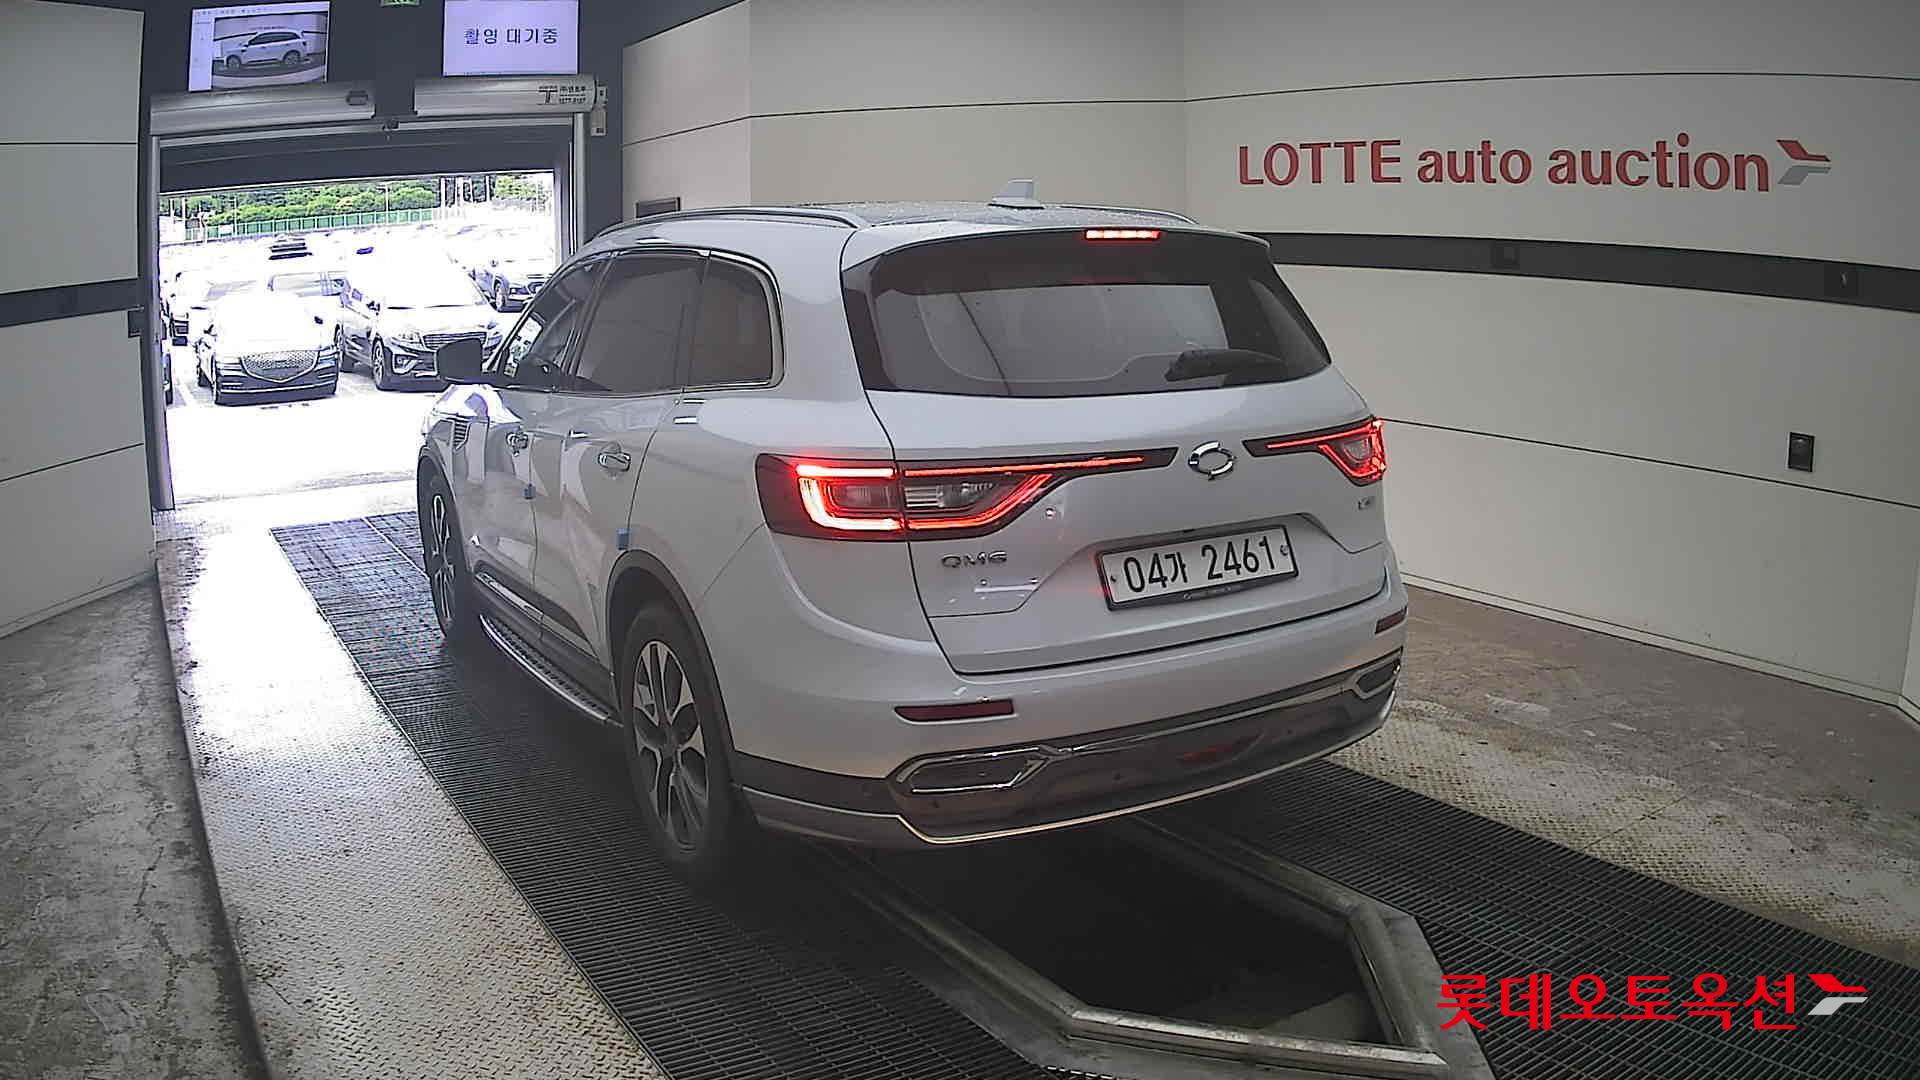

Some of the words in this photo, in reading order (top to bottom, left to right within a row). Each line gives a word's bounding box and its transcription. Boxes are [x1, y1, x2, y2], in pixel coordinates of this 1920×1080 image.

[506, 28, 559, 45] 대기중
[1238, 139, 1401, 185] LOTTE
[1416, 140, 1532, 185] auto
[1547, 132, 1770, 192] auction
[1123, 551, 1189, 593] 04가
[1200, 535, 1275, 580] 2461
